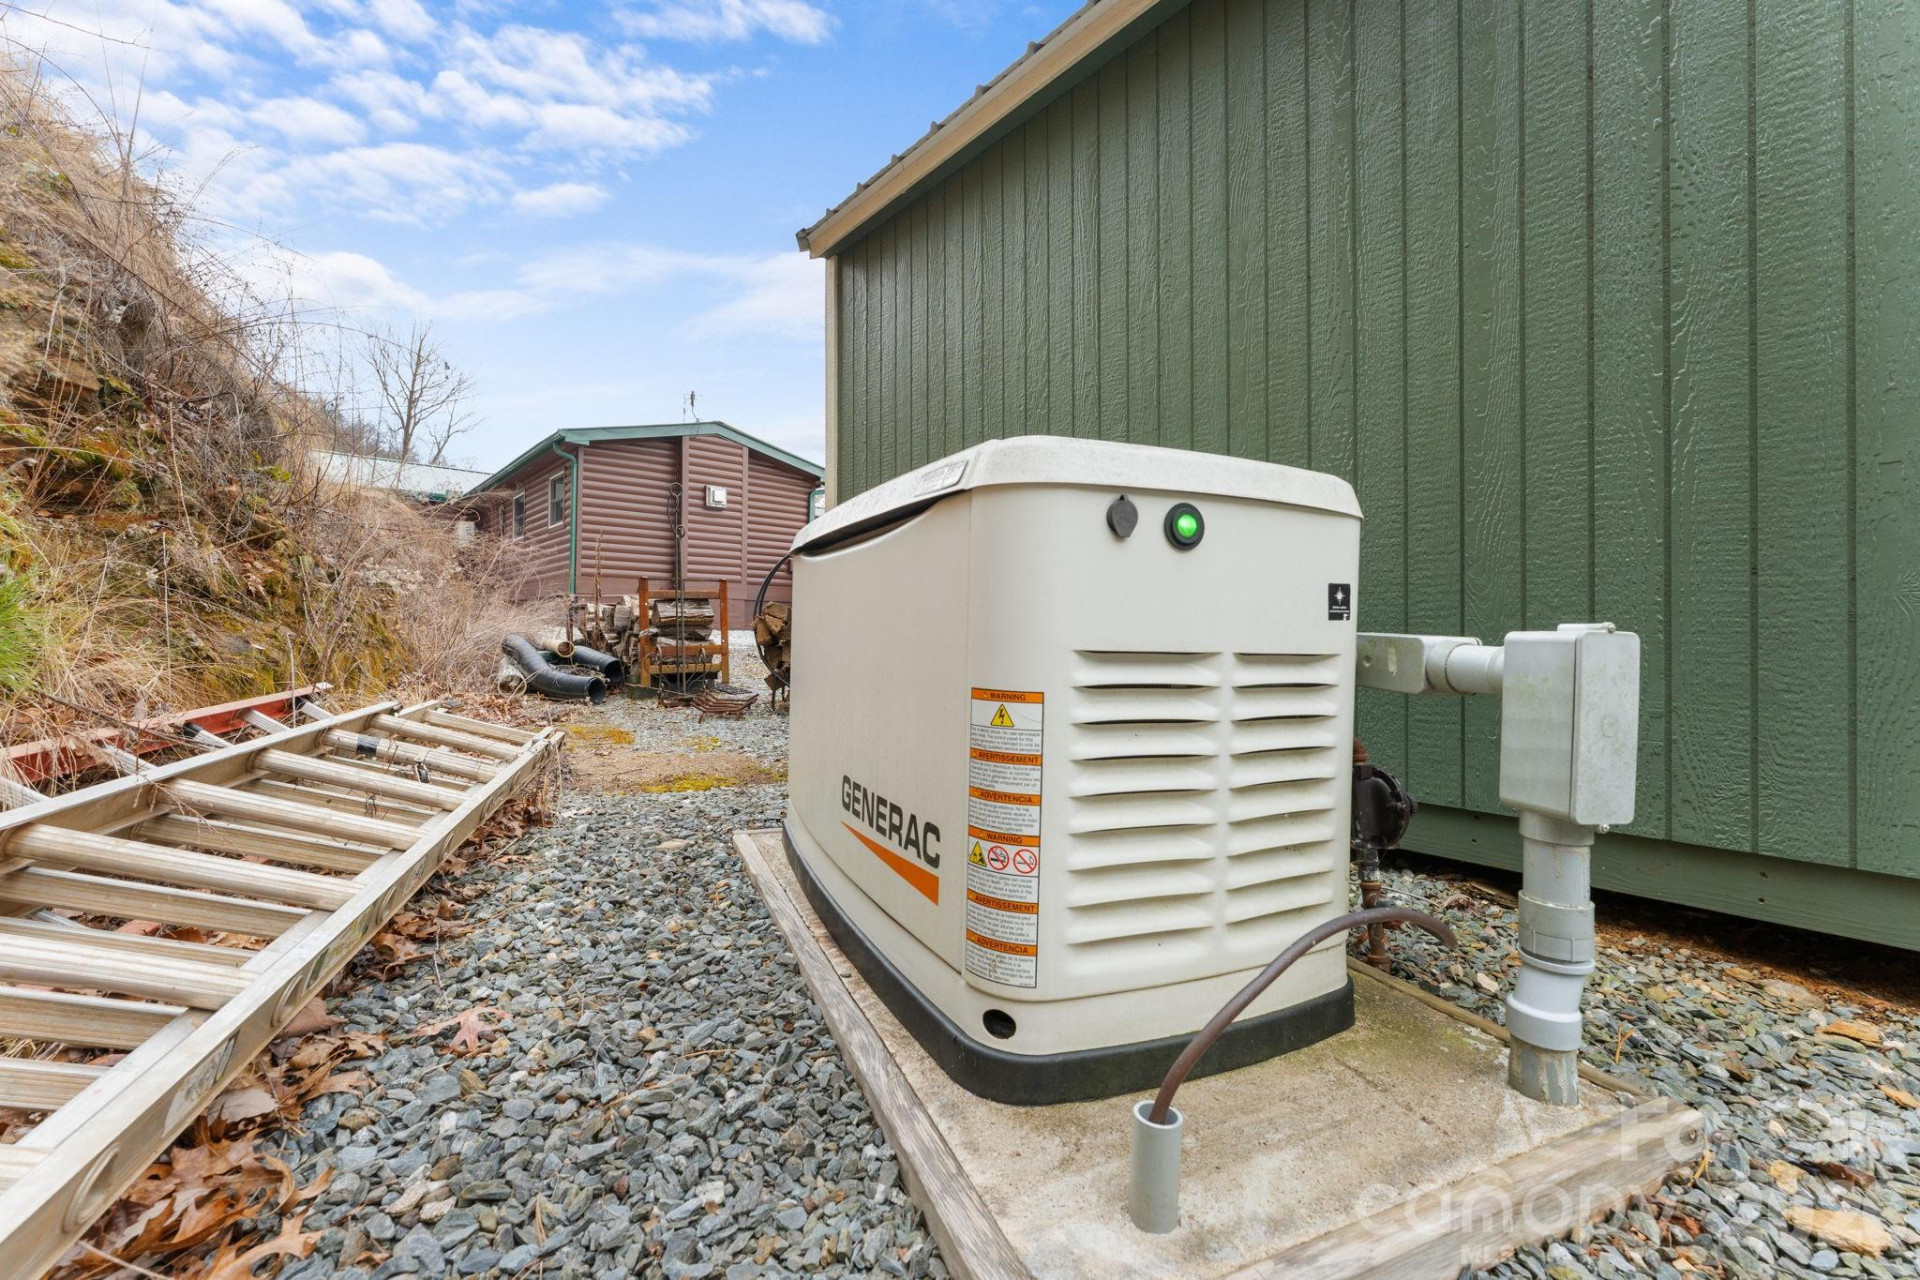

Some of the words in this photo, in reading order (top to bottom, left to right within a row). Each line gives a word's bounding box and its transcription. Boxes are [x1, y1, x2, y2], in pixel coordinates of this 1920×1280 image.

[990, 692, 1026, 702] WARNING
[978, 751, 1039, 764] AVERTISSEMENT
[980, 790, 1033, 803] ADVERTENCIA
[841, 774, 941, 869] GENERAC
[986, 832, 1023, 845] WARNING
[974, 895, 1036, 912] AVERTISSEMENT
[976, 936, 1029, 954] ADVERTENCIA
